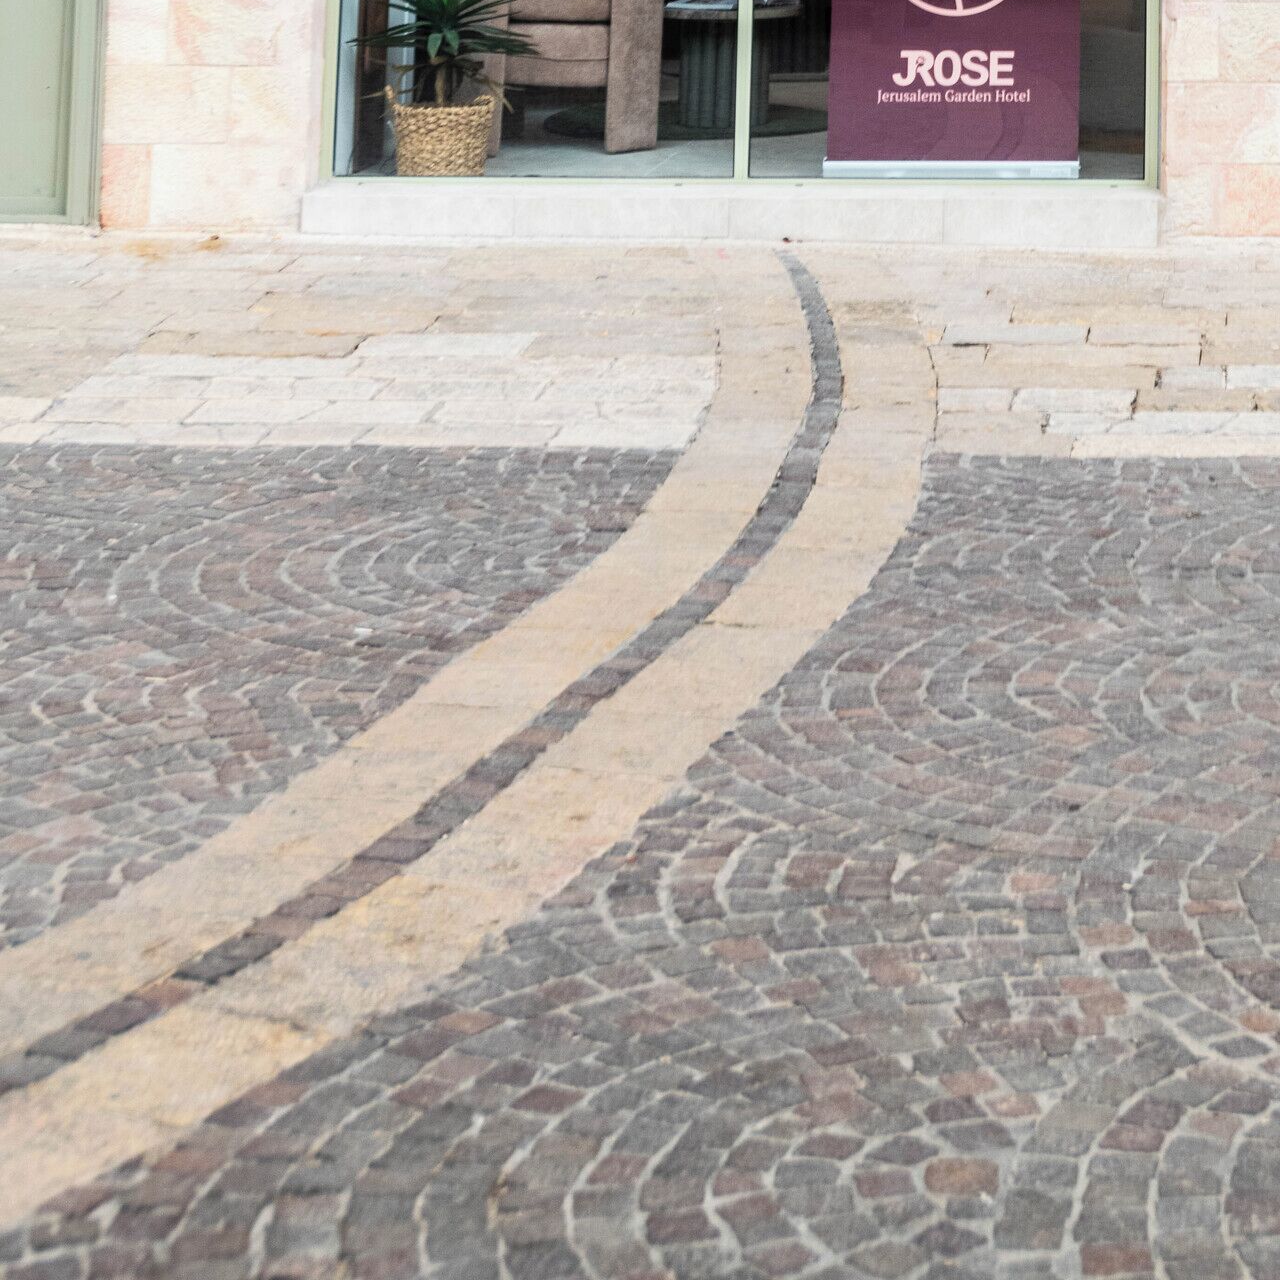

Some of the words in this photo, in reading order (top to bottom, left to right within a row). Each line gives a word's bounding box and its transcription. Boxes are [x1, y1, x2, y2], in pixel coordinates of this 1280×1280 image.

[892, 49, 1015, 87] JROSE
[877, 89, 941, 104] Jerusalem
[944, 89, 992, 103] Garden
[995, 88, 1031, 103] Hotel
